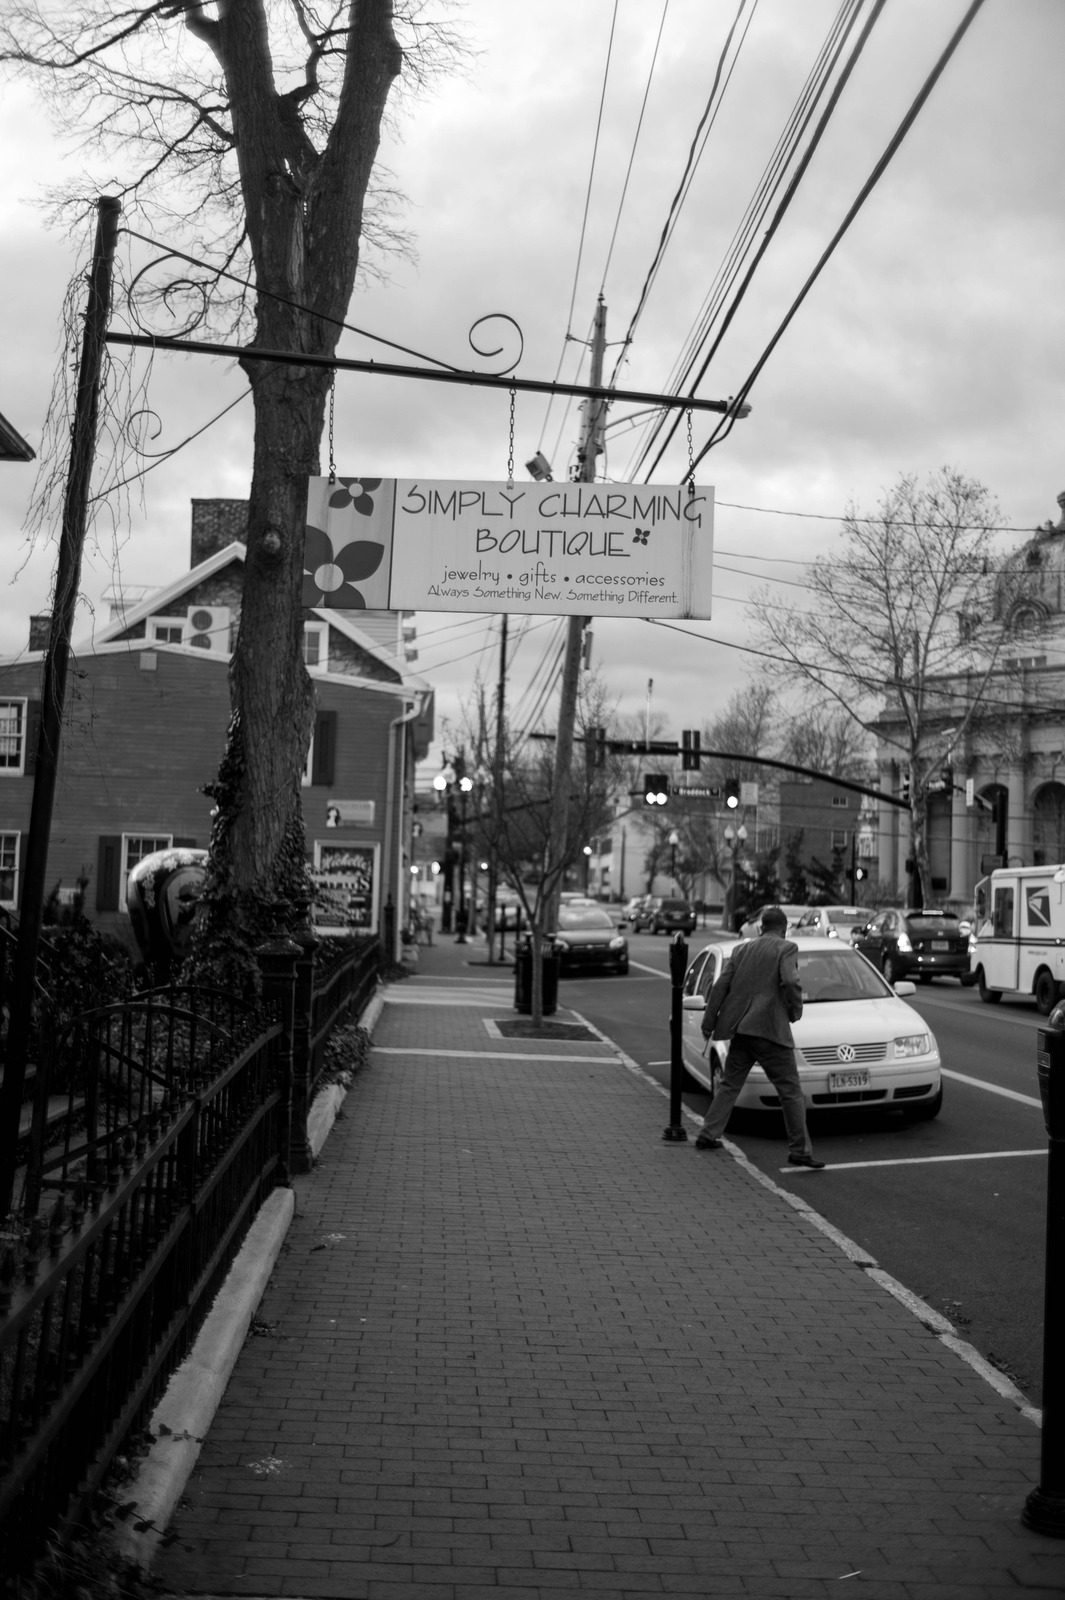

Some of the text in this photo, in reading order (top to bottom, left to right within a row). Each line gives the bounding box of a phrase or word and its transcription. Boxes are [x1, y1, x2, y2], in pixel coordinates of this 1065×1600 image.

[402, 484, 707, 529] SIMPLY CHARMING
[476, 528, 631, 557] BOUTIQUE
[441, 560, 665, 587] jewelry gifts accessories
[427, 585, 679, 604] Always Something New. Something Different.
[678, 787, 710, 797] Braddock
